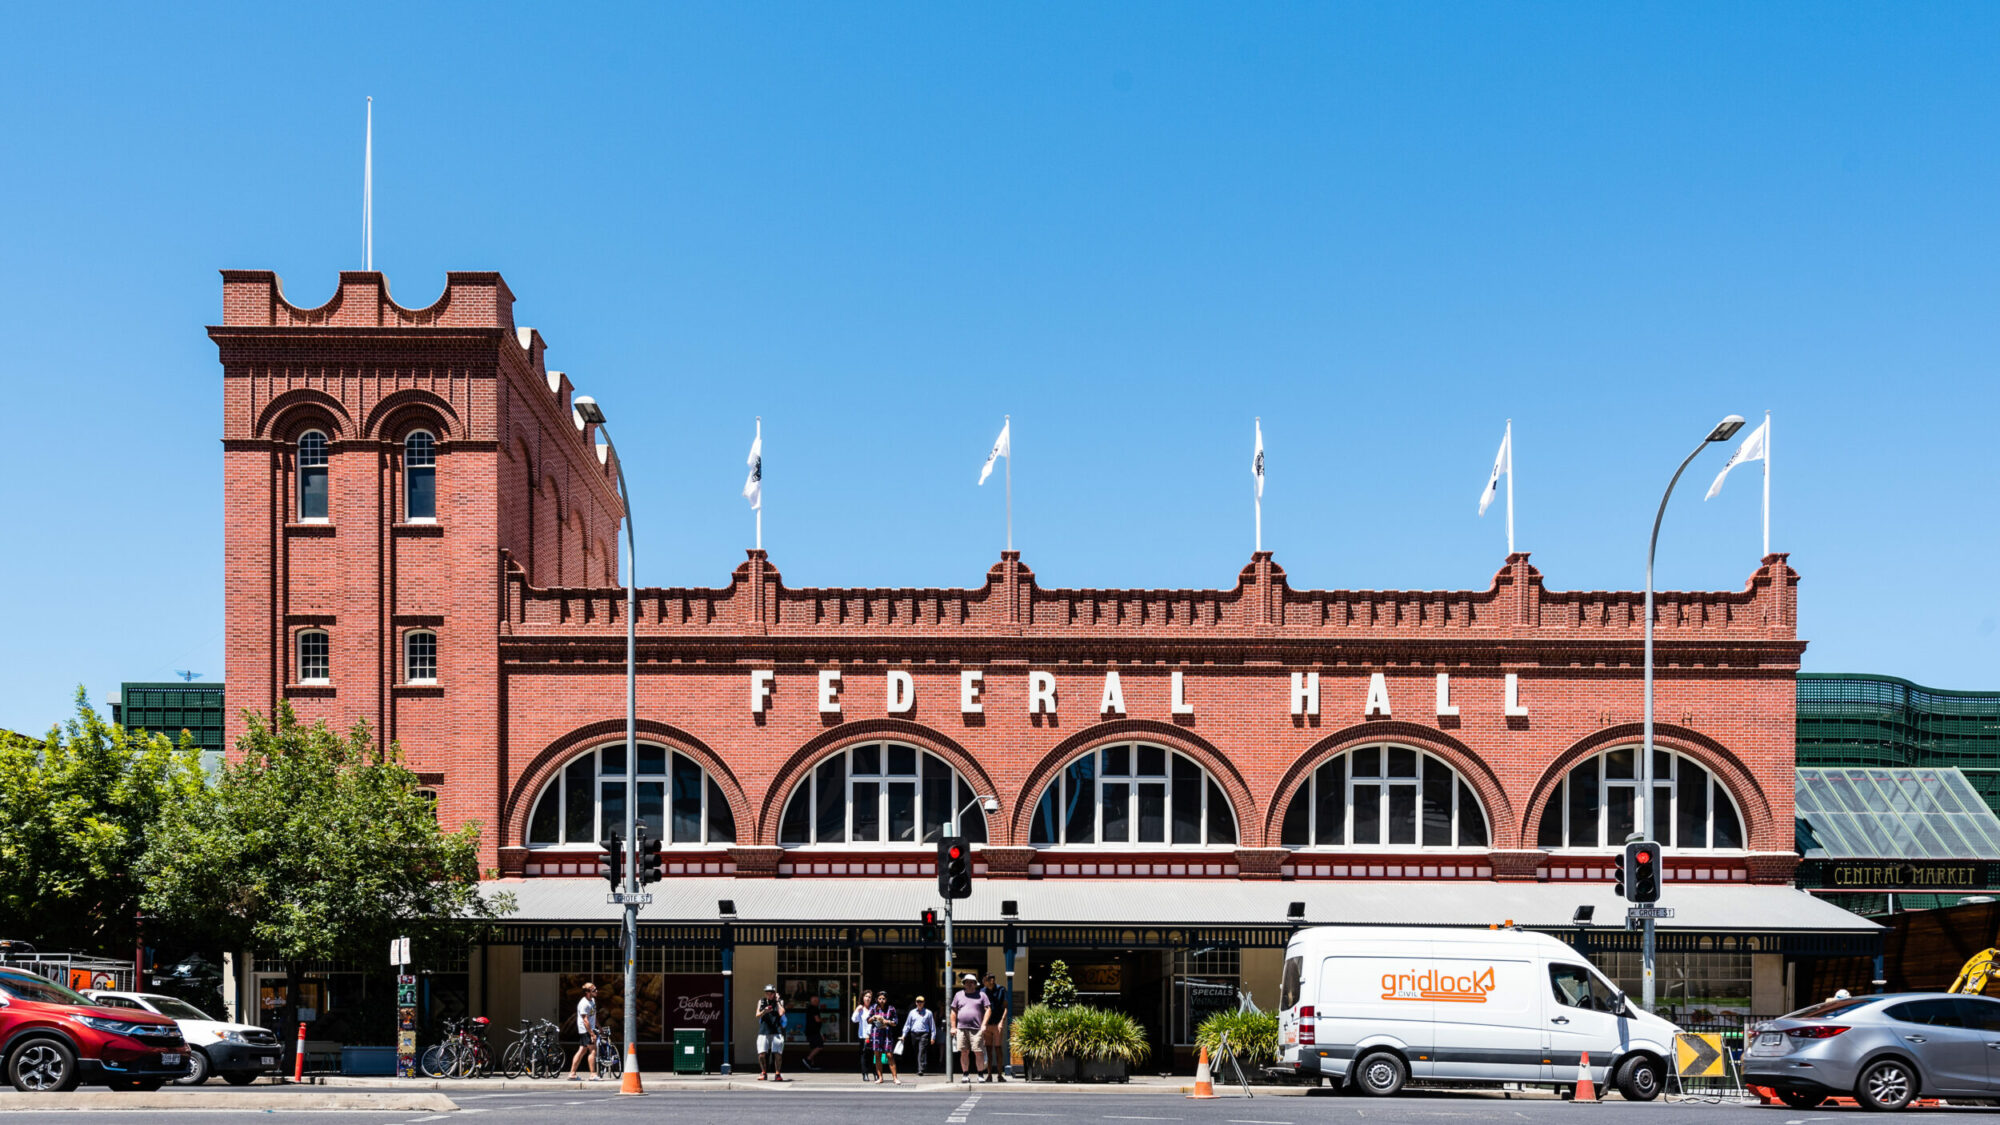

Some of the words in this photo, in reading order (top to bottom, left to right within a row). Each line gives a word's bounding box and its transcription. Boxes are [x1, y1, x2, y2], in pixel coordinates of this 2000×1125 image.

[751, 671, 1194, 713] FEDERAL
[1291, 672, 1528, 716] HALL
[1834, 867, 1904, 885] CENTRAL
[1912, 867, 1976, 885] MARKET
[1639, 909, 1660, 917] GROTE
[1663, 909, 1672, 917] ST
[1381, 966, 1496, 1000] gridlock
[1191, 988, 1234, 996] SPECIALS
[677, 996, 713, 1009] Bakers
[683, 1008, 720, 1025] Delight
